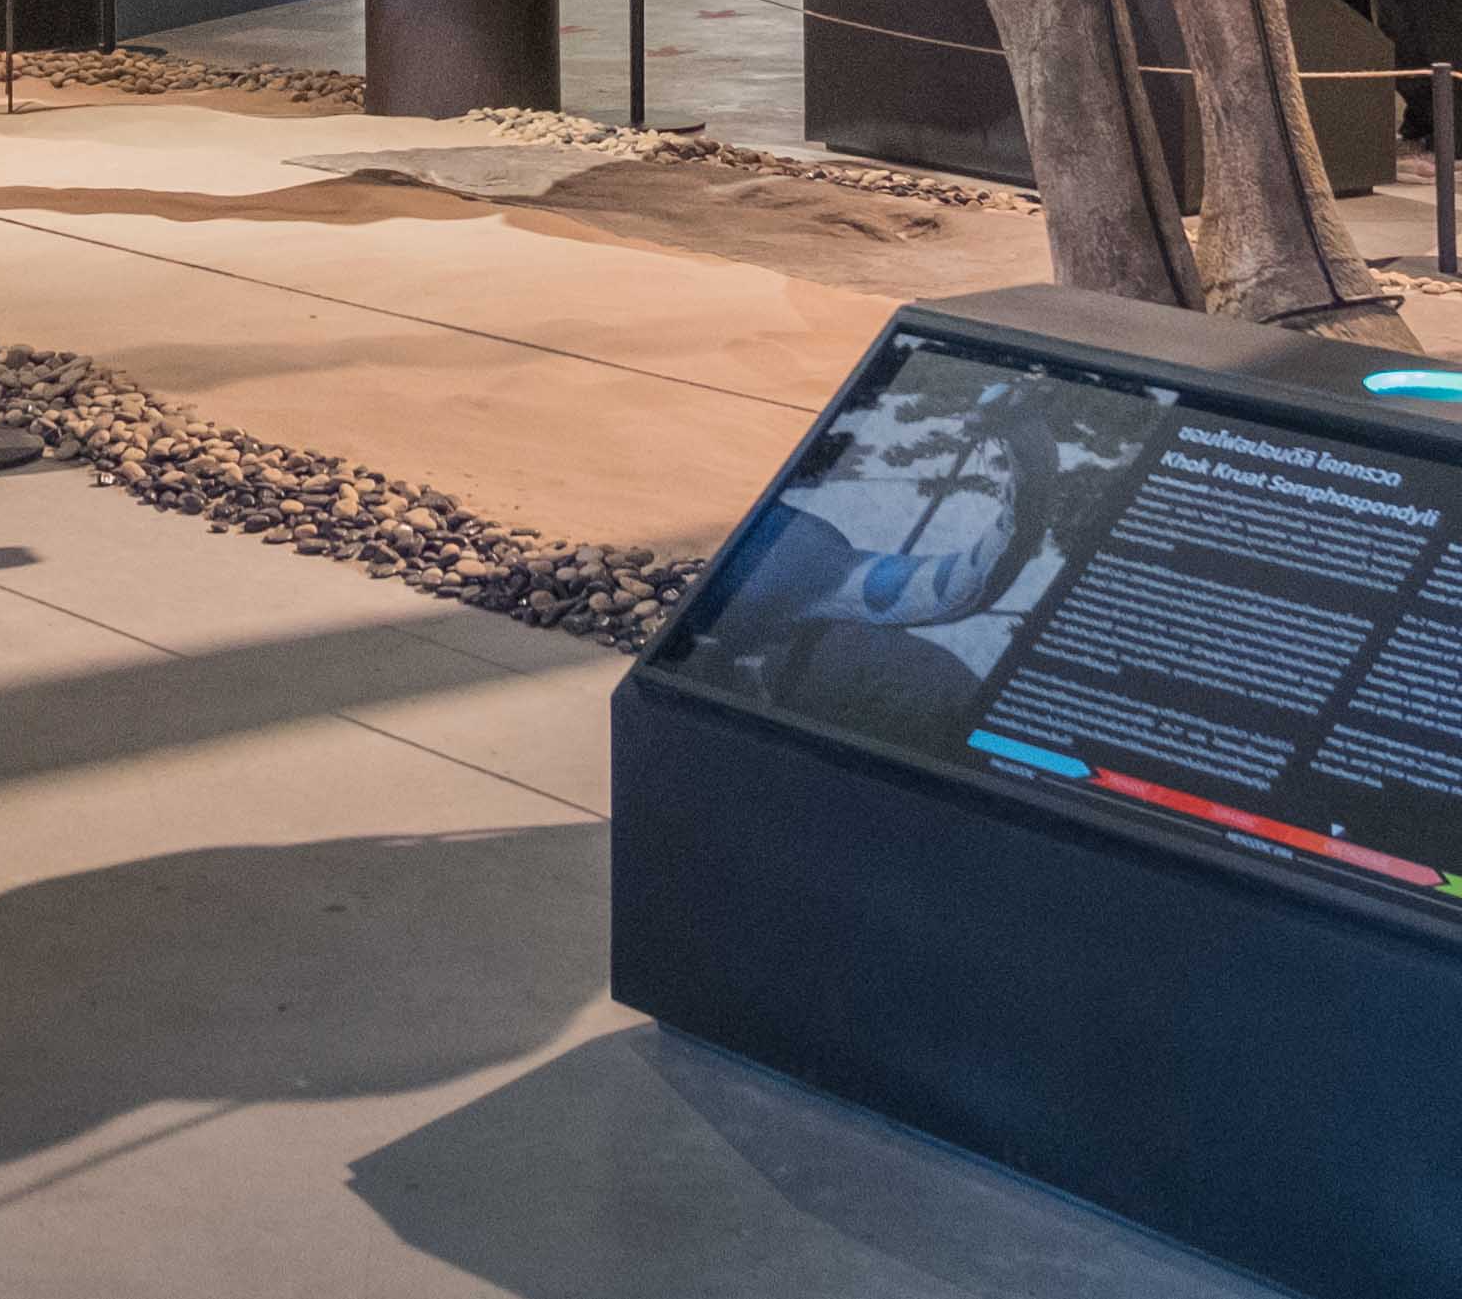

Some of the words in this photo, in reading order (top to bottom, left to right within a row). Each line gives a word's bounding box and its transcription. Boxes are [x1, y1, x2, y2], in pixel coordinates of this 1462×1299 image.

[1158, 450, 1214, 475] Khok
[1209, 461, 1272, 489] Kruat
[1266, 476, 1439, 527] Somphospondyli
